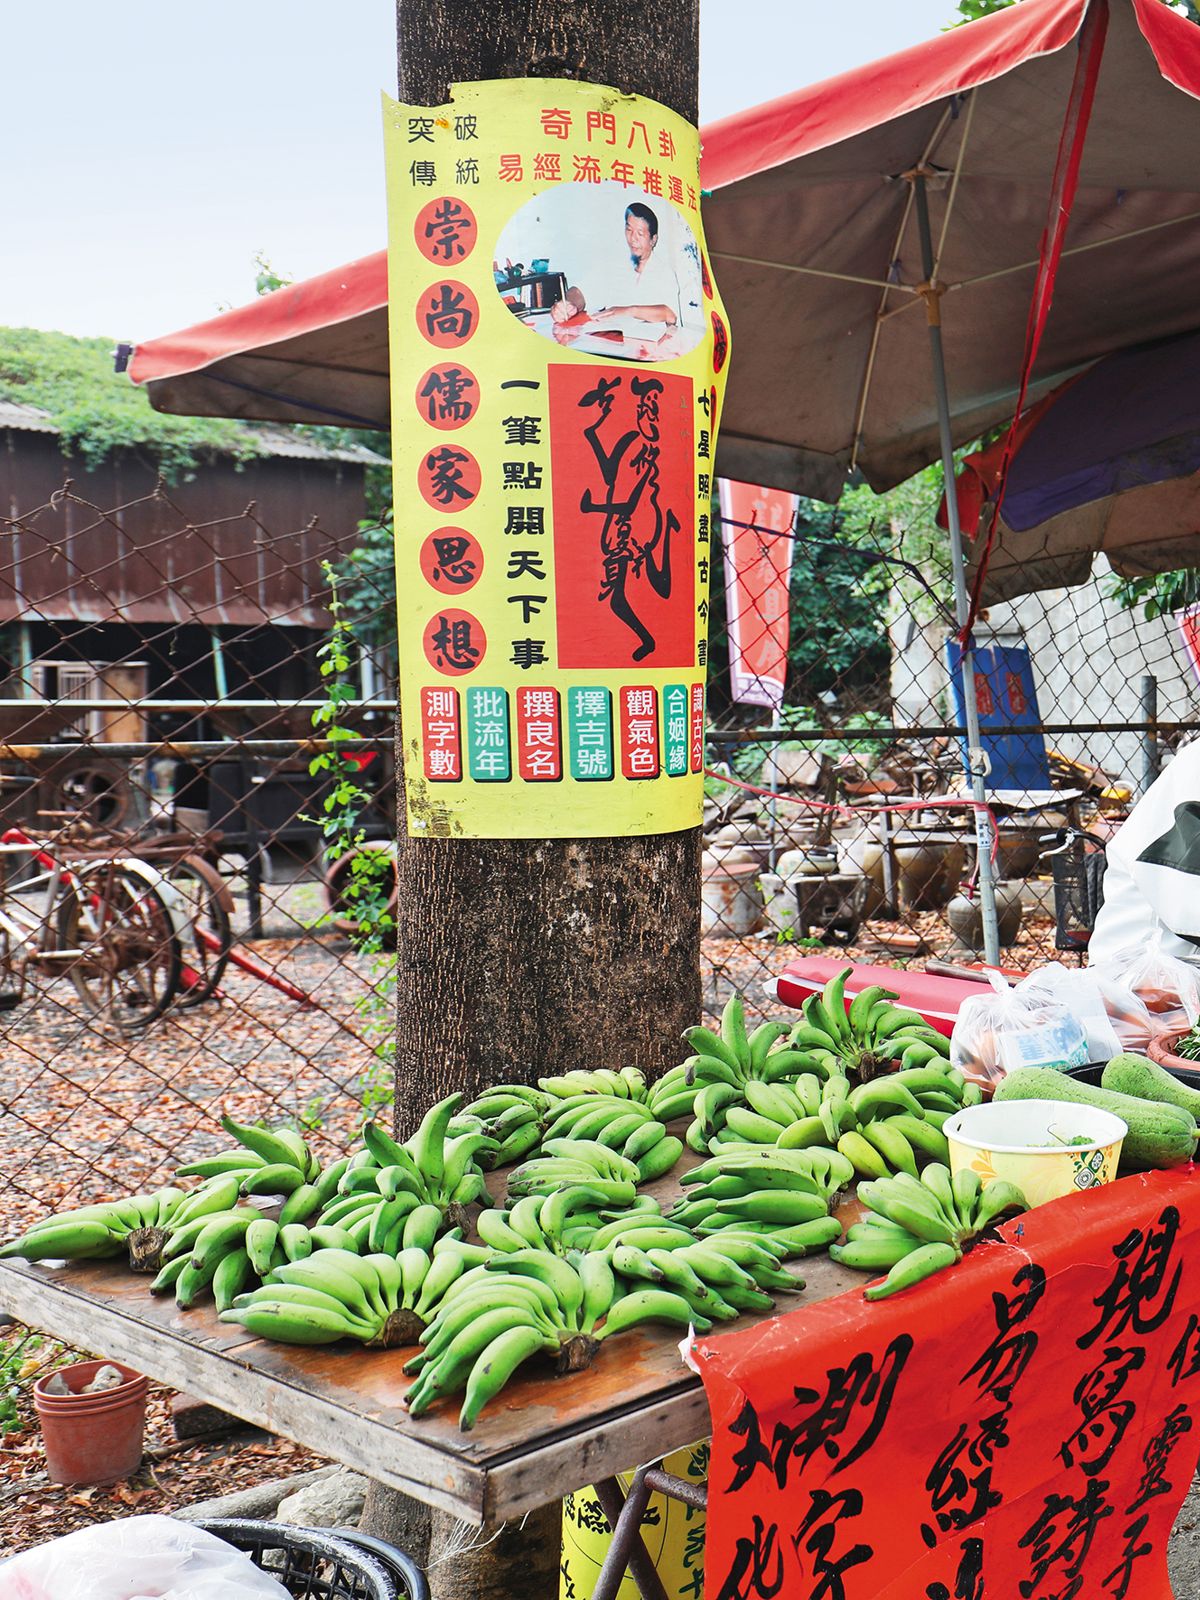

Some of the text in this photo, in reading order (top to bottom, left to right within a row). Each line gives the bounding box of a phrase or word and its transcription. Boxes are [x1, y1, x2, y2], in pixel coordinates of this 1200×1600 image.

[409, 156, 481, 187] 傳統
[540, 107, 677, 162] 奇門八卦
[420, 199, 481, 671] 崇尚儒家思想
[500, 378, 550, 670] 一筆點開天下事
[425, 690, 457, 777] 測字數
[472, 690, 506, 777] 批流年
[522, 690, 557, 777] 撰良名
[574, 690, 608, 776] 擇吉號
[626, 690, 655, 773] 觀氣色
[667, 688, 686, 771] 合姻緣
